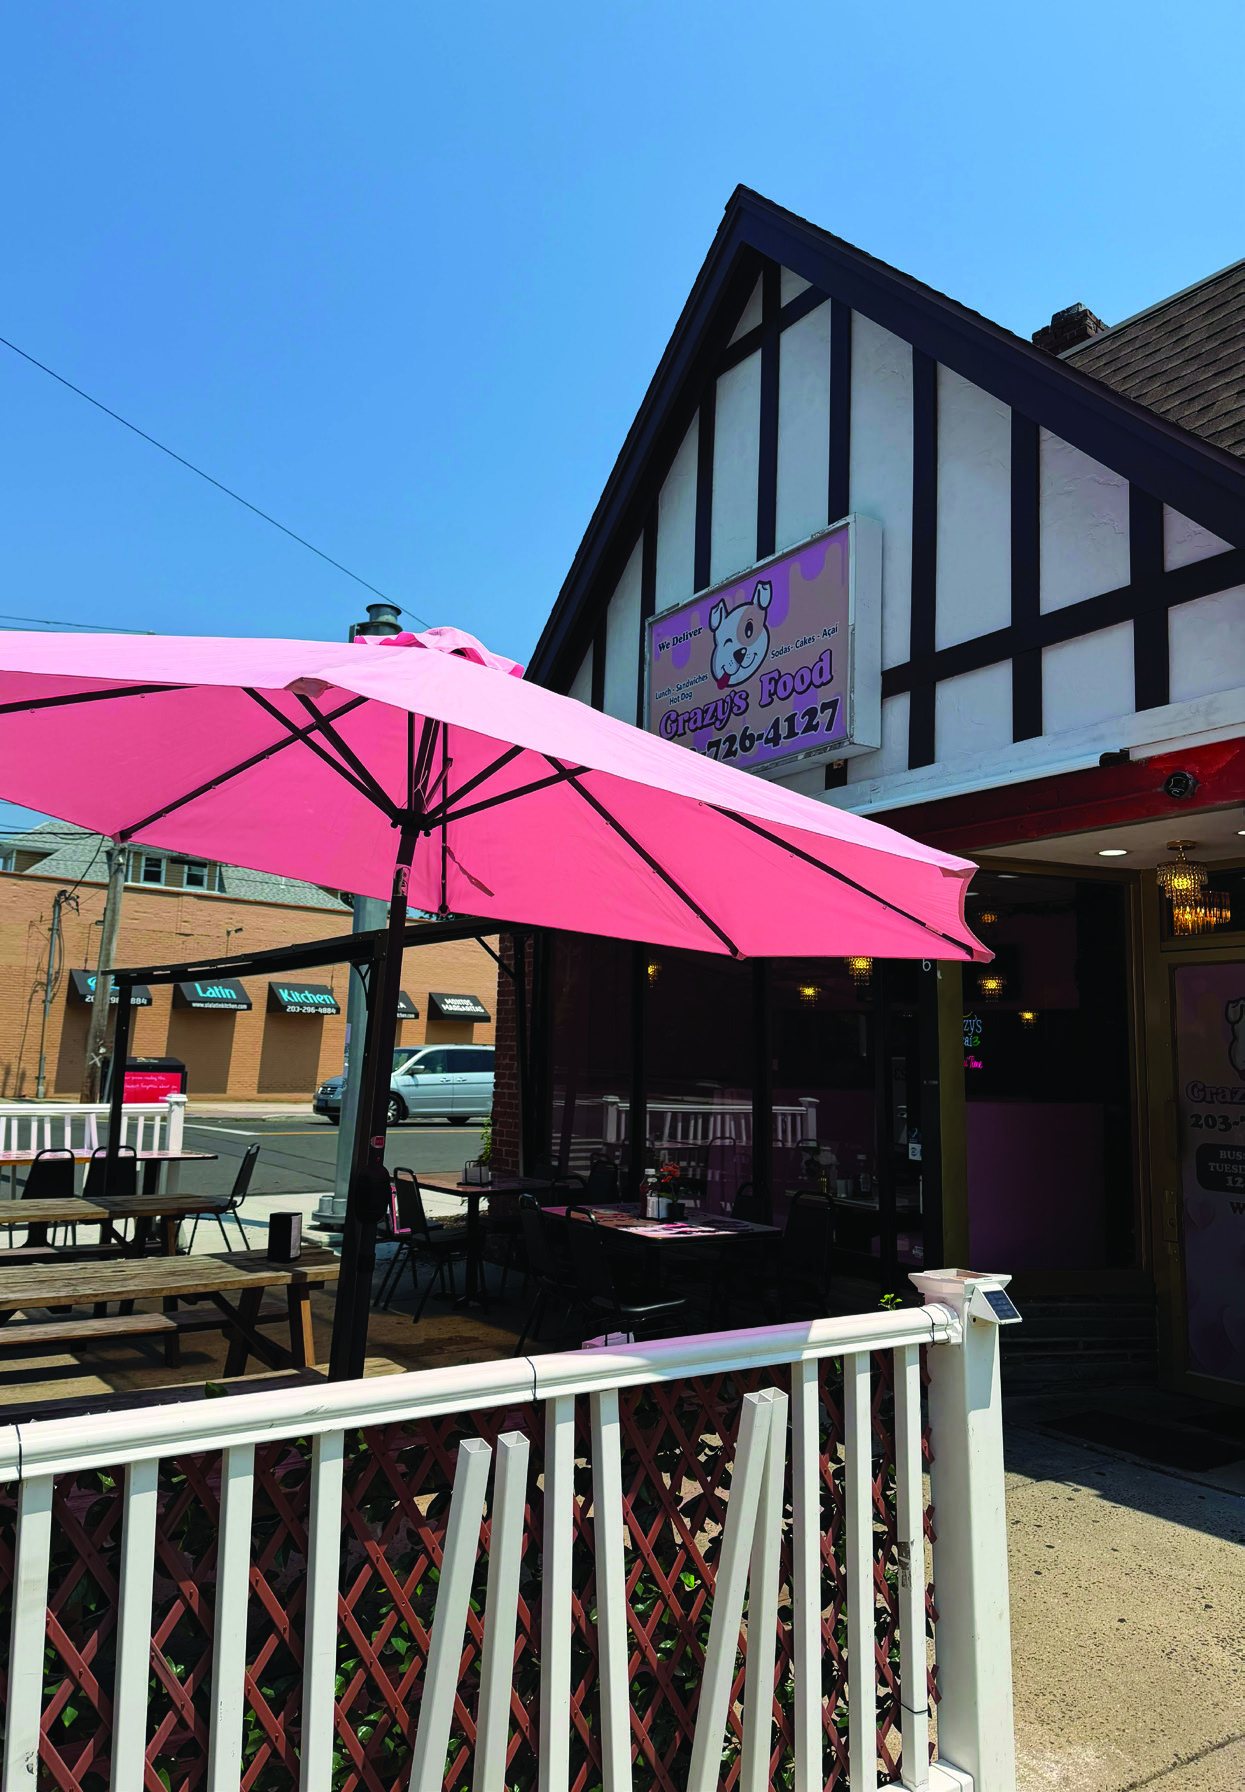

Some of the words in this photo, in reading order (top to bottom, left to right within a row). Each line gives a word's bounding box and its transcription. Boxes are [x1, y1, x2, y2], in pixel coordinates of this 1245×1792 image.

[658, 637, 671, 653] We
[672, 625, 703, 647] Deliver
[795, 636, 816, 651] Cakes
[655, 686, 671, 700] Lunch
[676, 672, 708, 692] Sandwiches
[759, 648, 833, 709] Food
[669, 694, 680, 705] Hot
[681, 691, 693, 702] Dog
[690, 697, 840, 762] -726-4127
[194, 982, 237, 1000] Latin
[278, 988, 335, 1005] Kitchen
[286, 1005, 336, 1015] 203-296-4884
[441, 1004, 485, 1013] MARGARITAS
[963, 1014, 983, 1035] zy's
